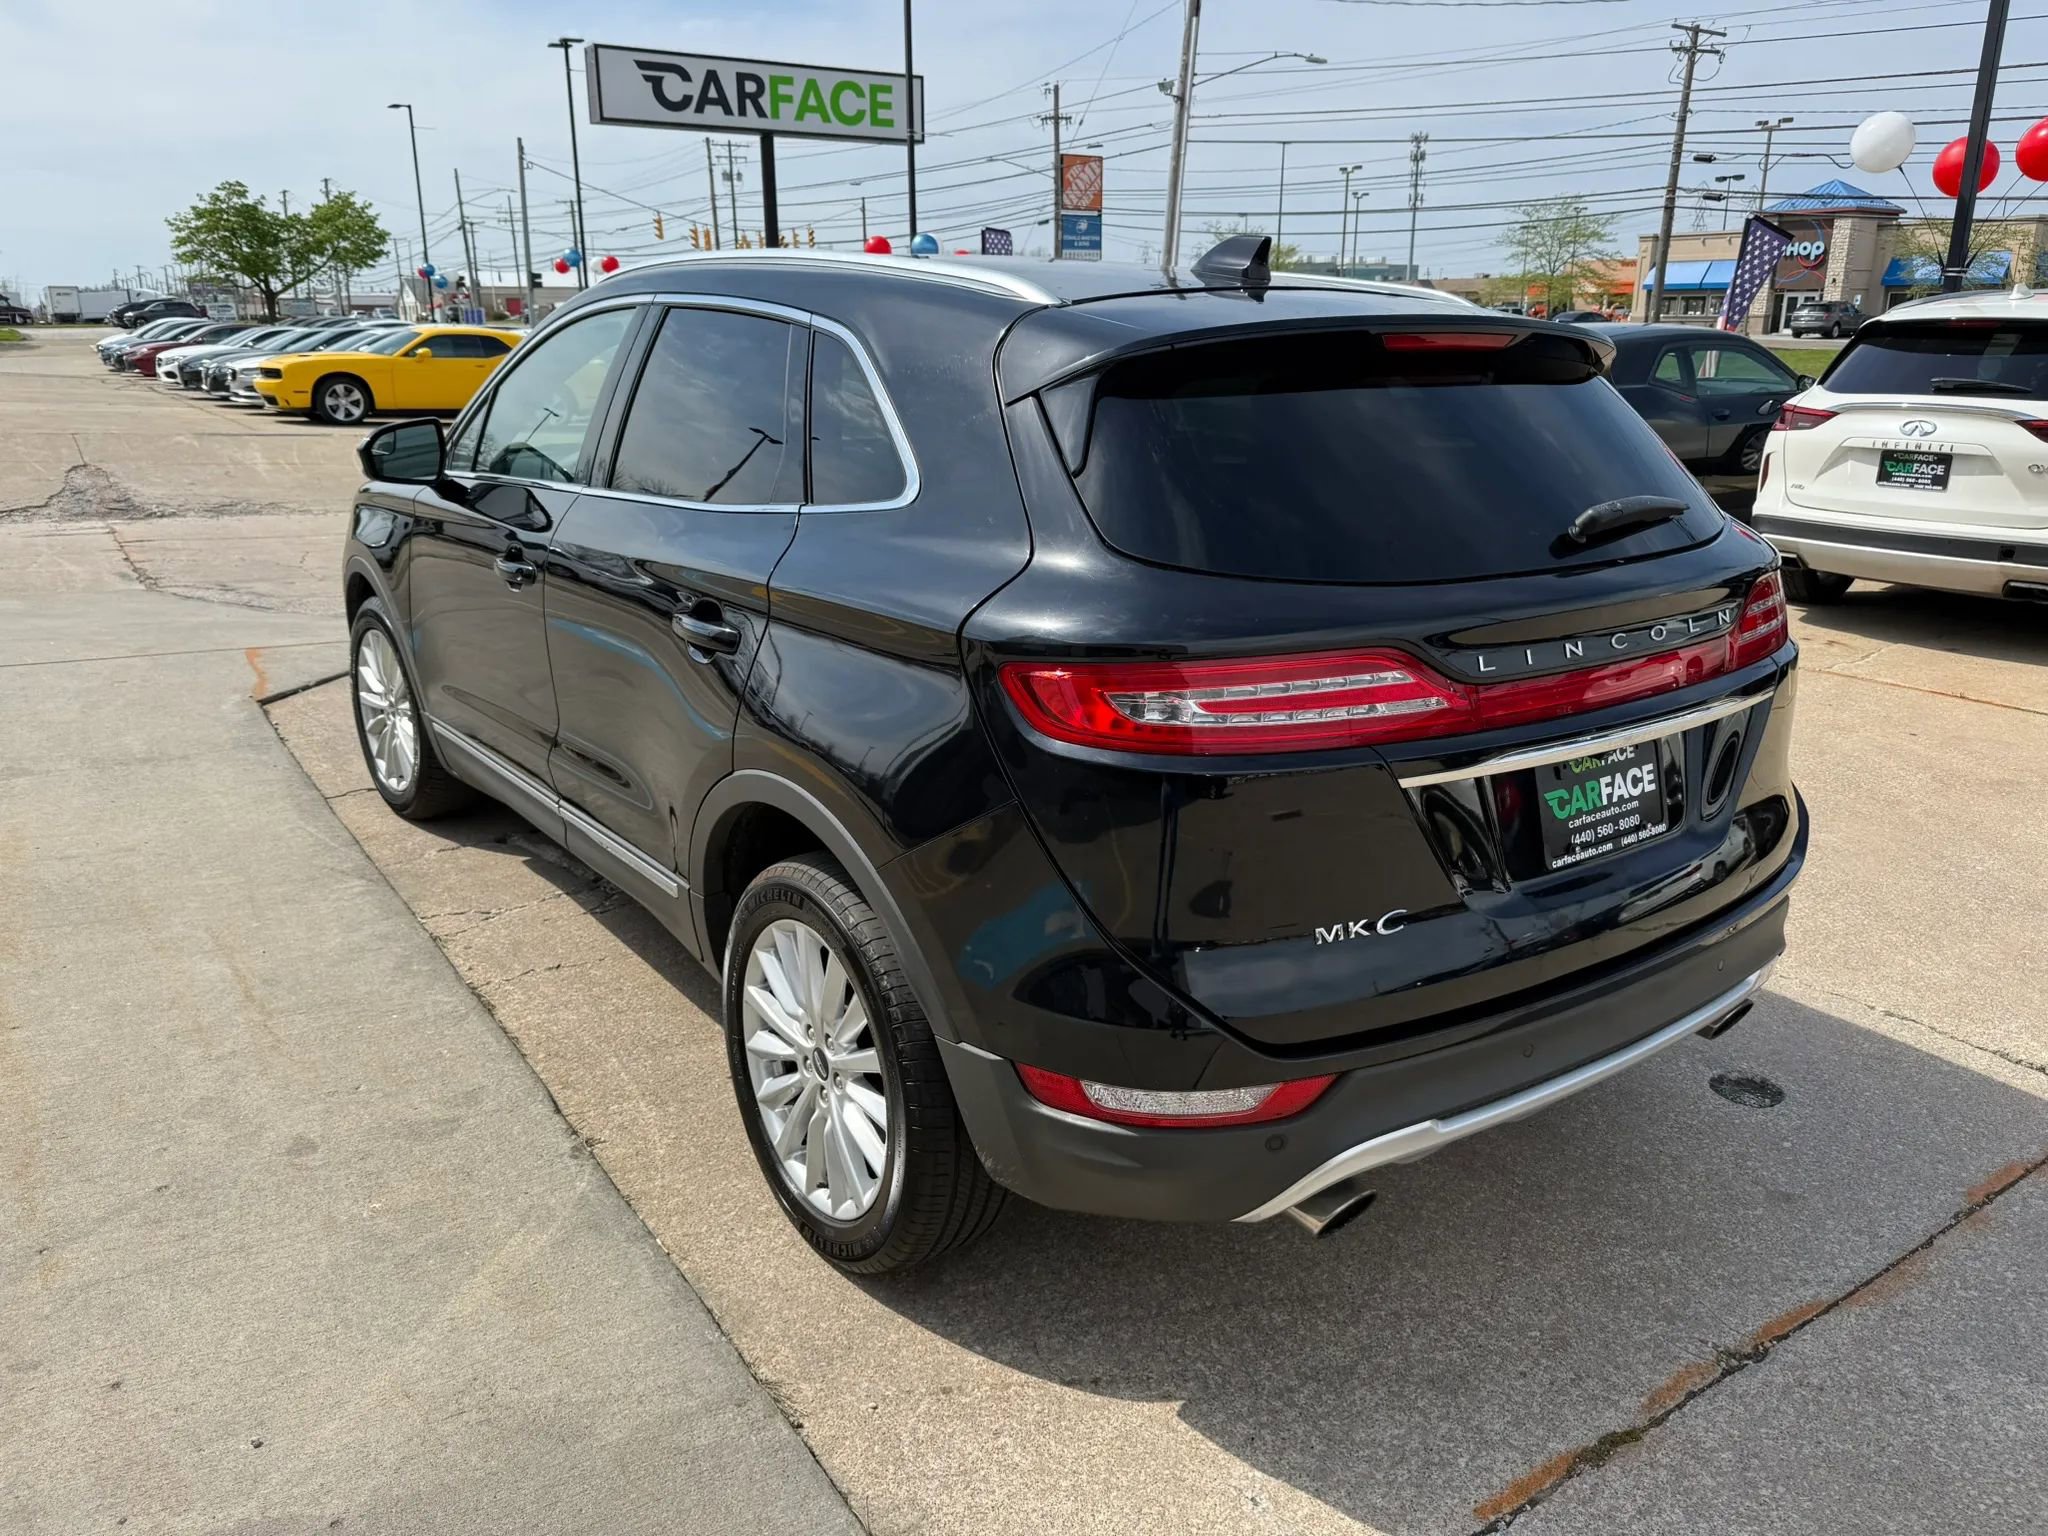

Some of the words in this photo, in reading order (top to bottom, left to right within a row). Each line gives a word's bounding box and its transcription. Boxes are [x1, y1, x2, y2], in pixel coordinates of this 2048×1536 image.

[633, 60, 895, 128] CARFACE
[1872, 440, 1954, 453] INFINITI
[1884, 461, 1945, 475] CARFACE
[1478, 608, 1732, 672] LINCOLN
[1543, 763, 1657, 820] CARFACE
[1568, 799, 1639, 829] carfaceauto.com
[1571, 829, 1595, 845] (440)
[1551, 842, 1613, 868] carfaceauto.com
[1314, 909, 1408, 945] MKC
